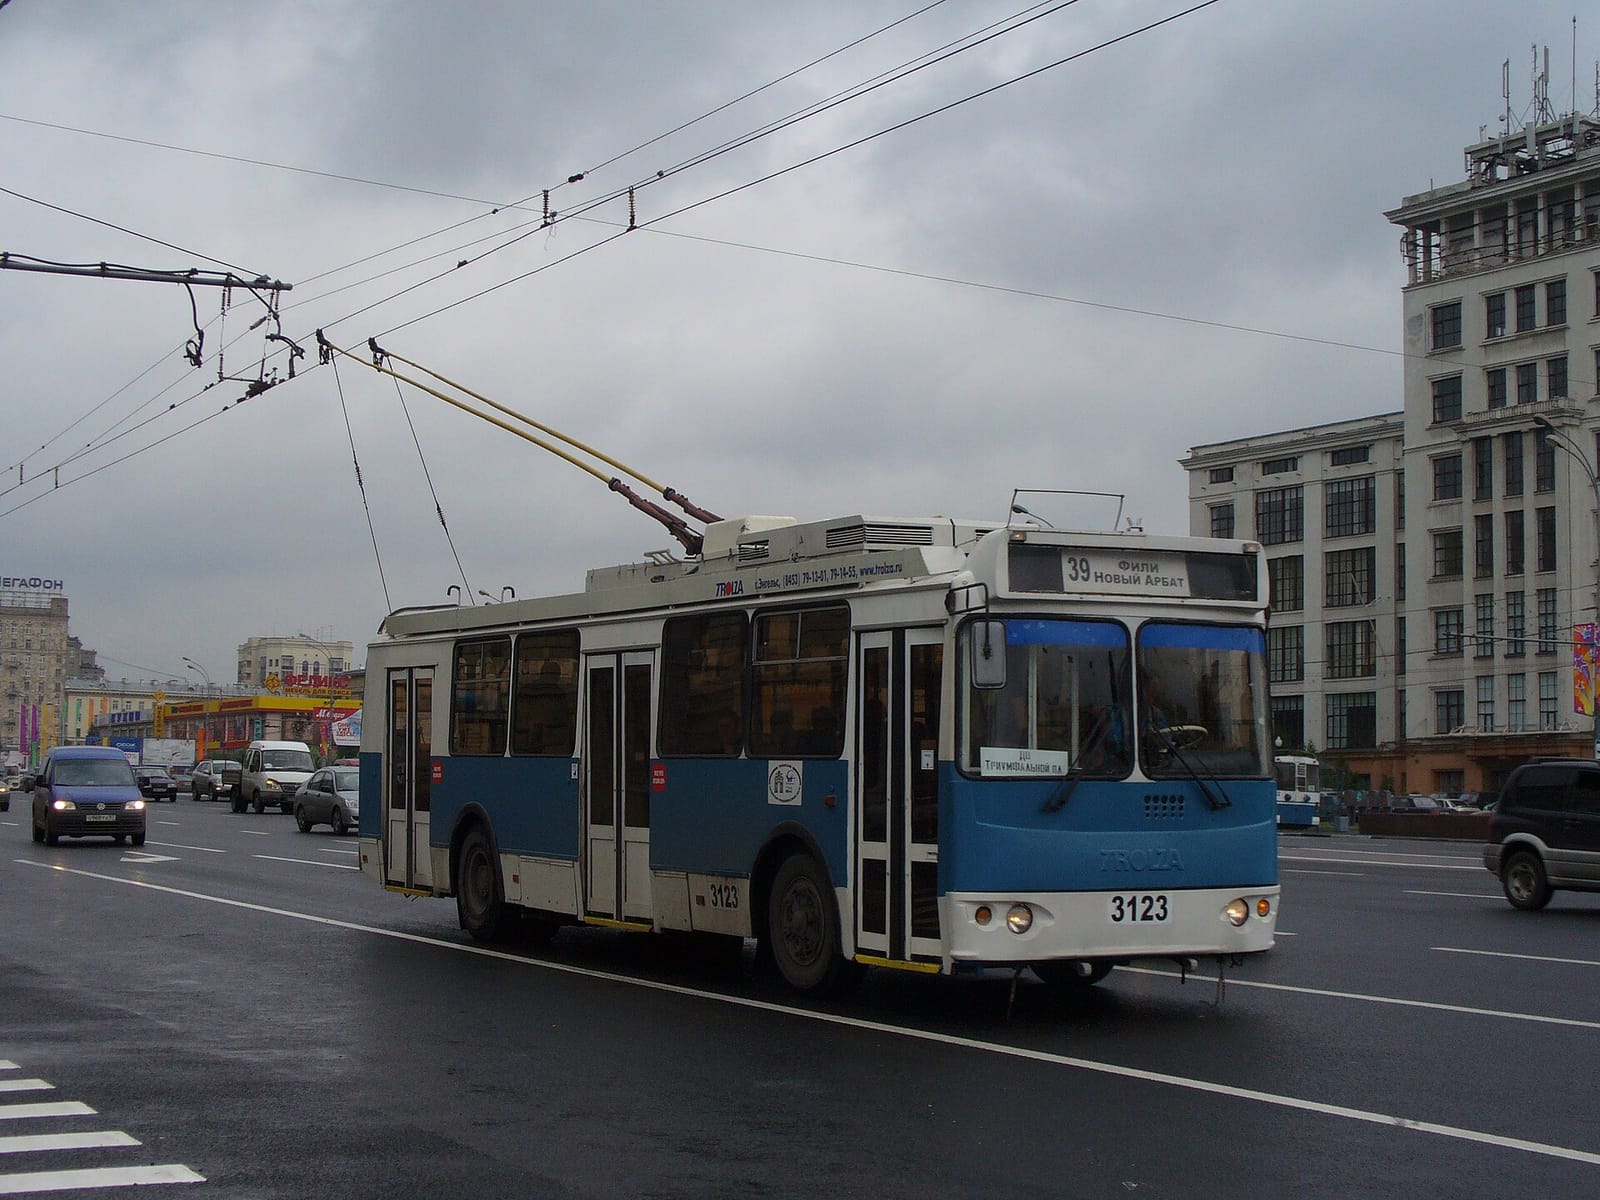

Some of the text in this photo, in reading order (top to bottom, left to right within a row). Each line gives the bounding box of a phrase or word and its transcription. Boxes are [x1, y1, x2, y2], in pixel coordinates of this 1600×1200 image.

[1067, 556, 1091, 582] 39
[1117, 559, 1160, 573] ФИЛИ
[0, 576, 64, 590] ЕГАФОН
[715, 579, 744, 598] TROLZA
[1144, 573, 1185, 588] АРБАТ
[1098, 848, 1185, 872] TROLZA
[711, 883, 739, 909] 3123
[1111, 895, 1168, 922] 3123
